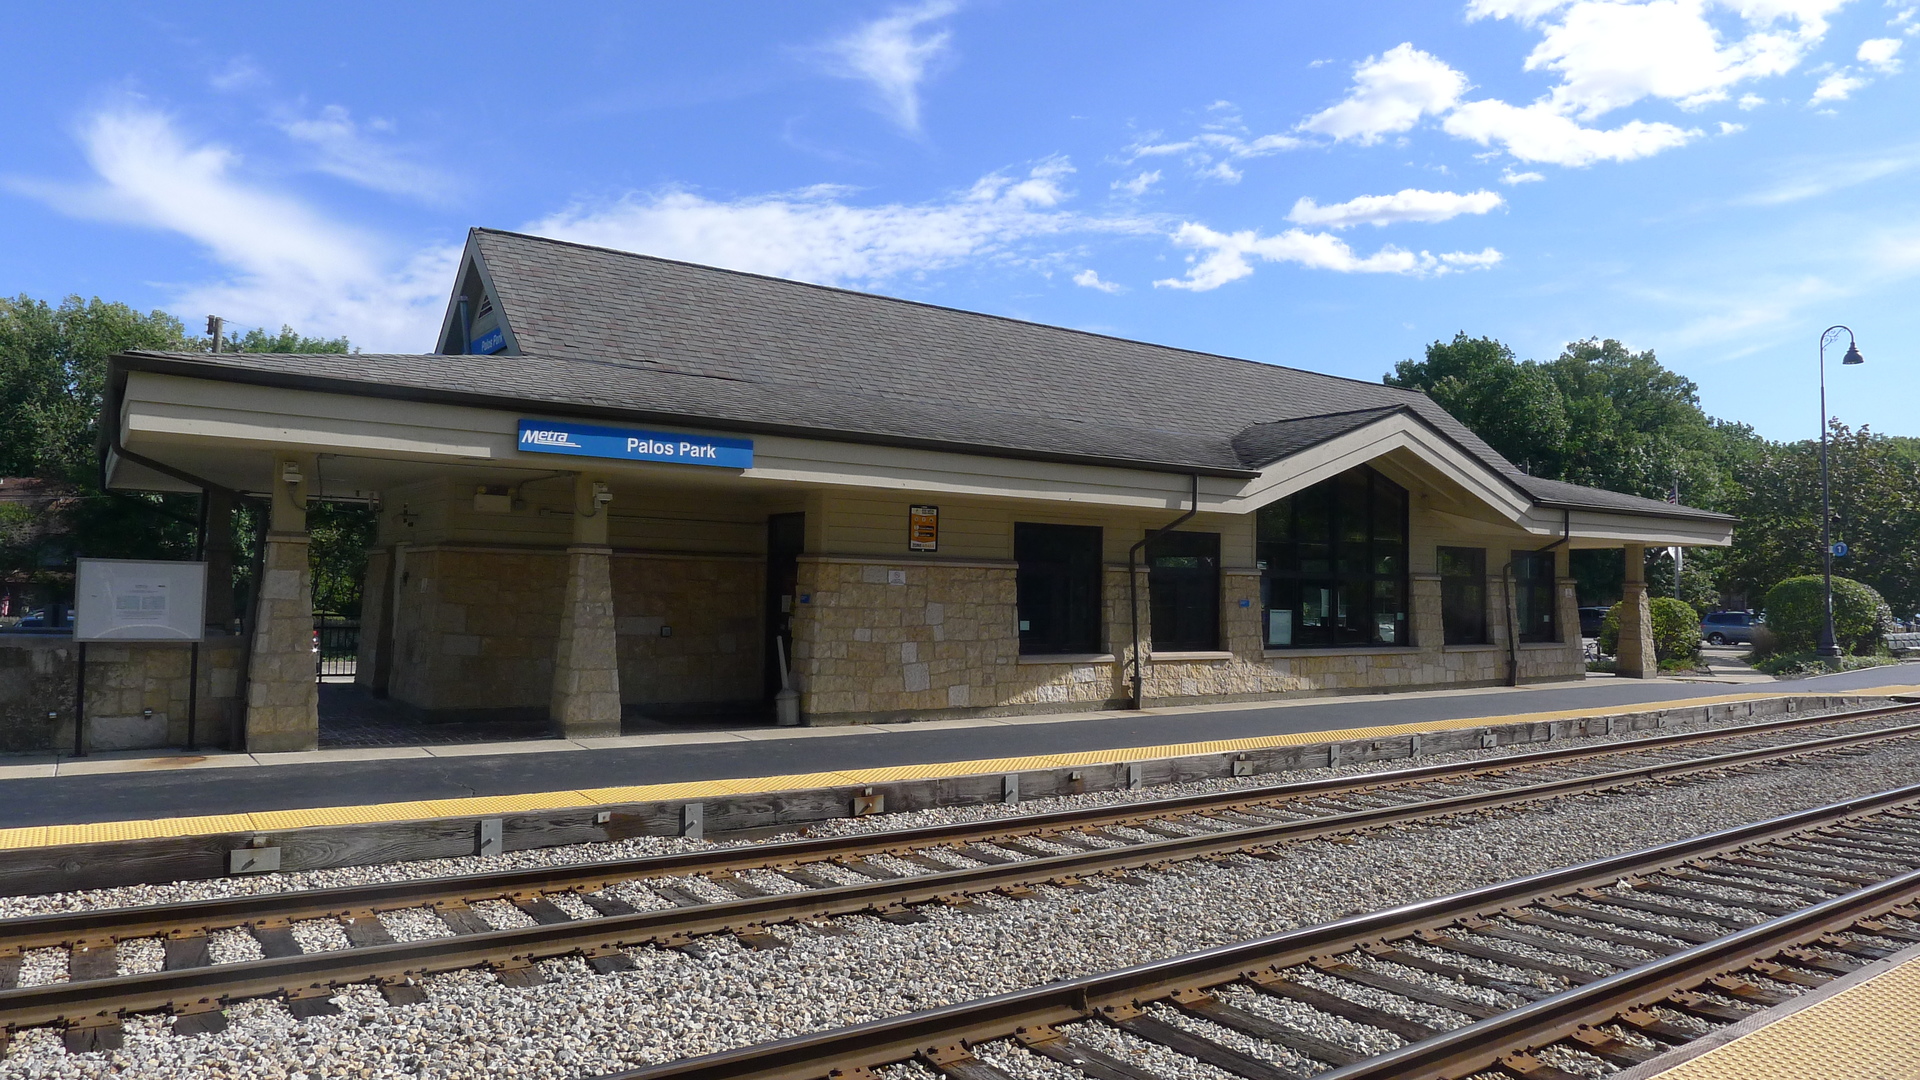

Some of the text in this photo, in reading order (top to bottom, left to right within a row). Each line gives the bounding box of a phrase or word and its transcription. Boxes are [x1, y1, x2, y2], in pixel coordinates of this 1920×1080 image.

[521, 429, 570, 445] Metra
[627, 437, 716, 459] Palos Park
